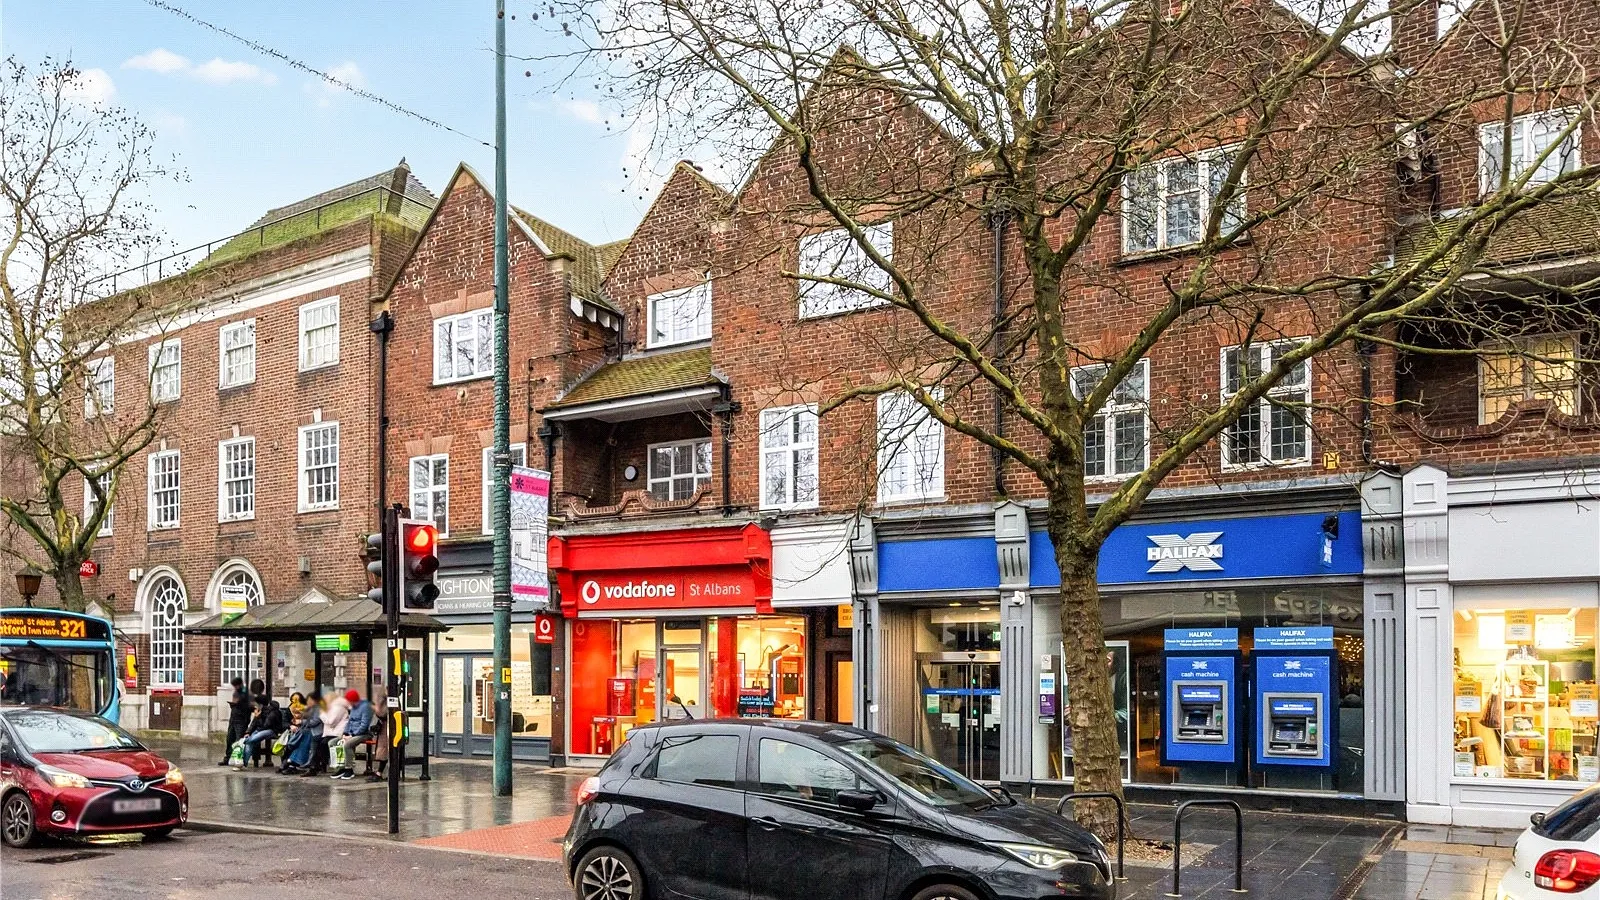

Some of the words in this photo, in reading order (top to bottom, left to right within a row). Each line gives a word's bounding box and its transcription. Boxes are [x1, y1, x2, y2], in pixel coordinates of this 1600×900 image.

[1147, 544, 1223, 561] HALIFAX
[436, 577, 494, 595] IGHTONS
[604, 581, 676, 599] vodafone
[689, 584, 701, 596] St
[703, 583, 741, 596] Albans
[27, 618, 35, 626] St
[36, 619, 56, 627] Albans
[60, 619, 85, 638] 321
